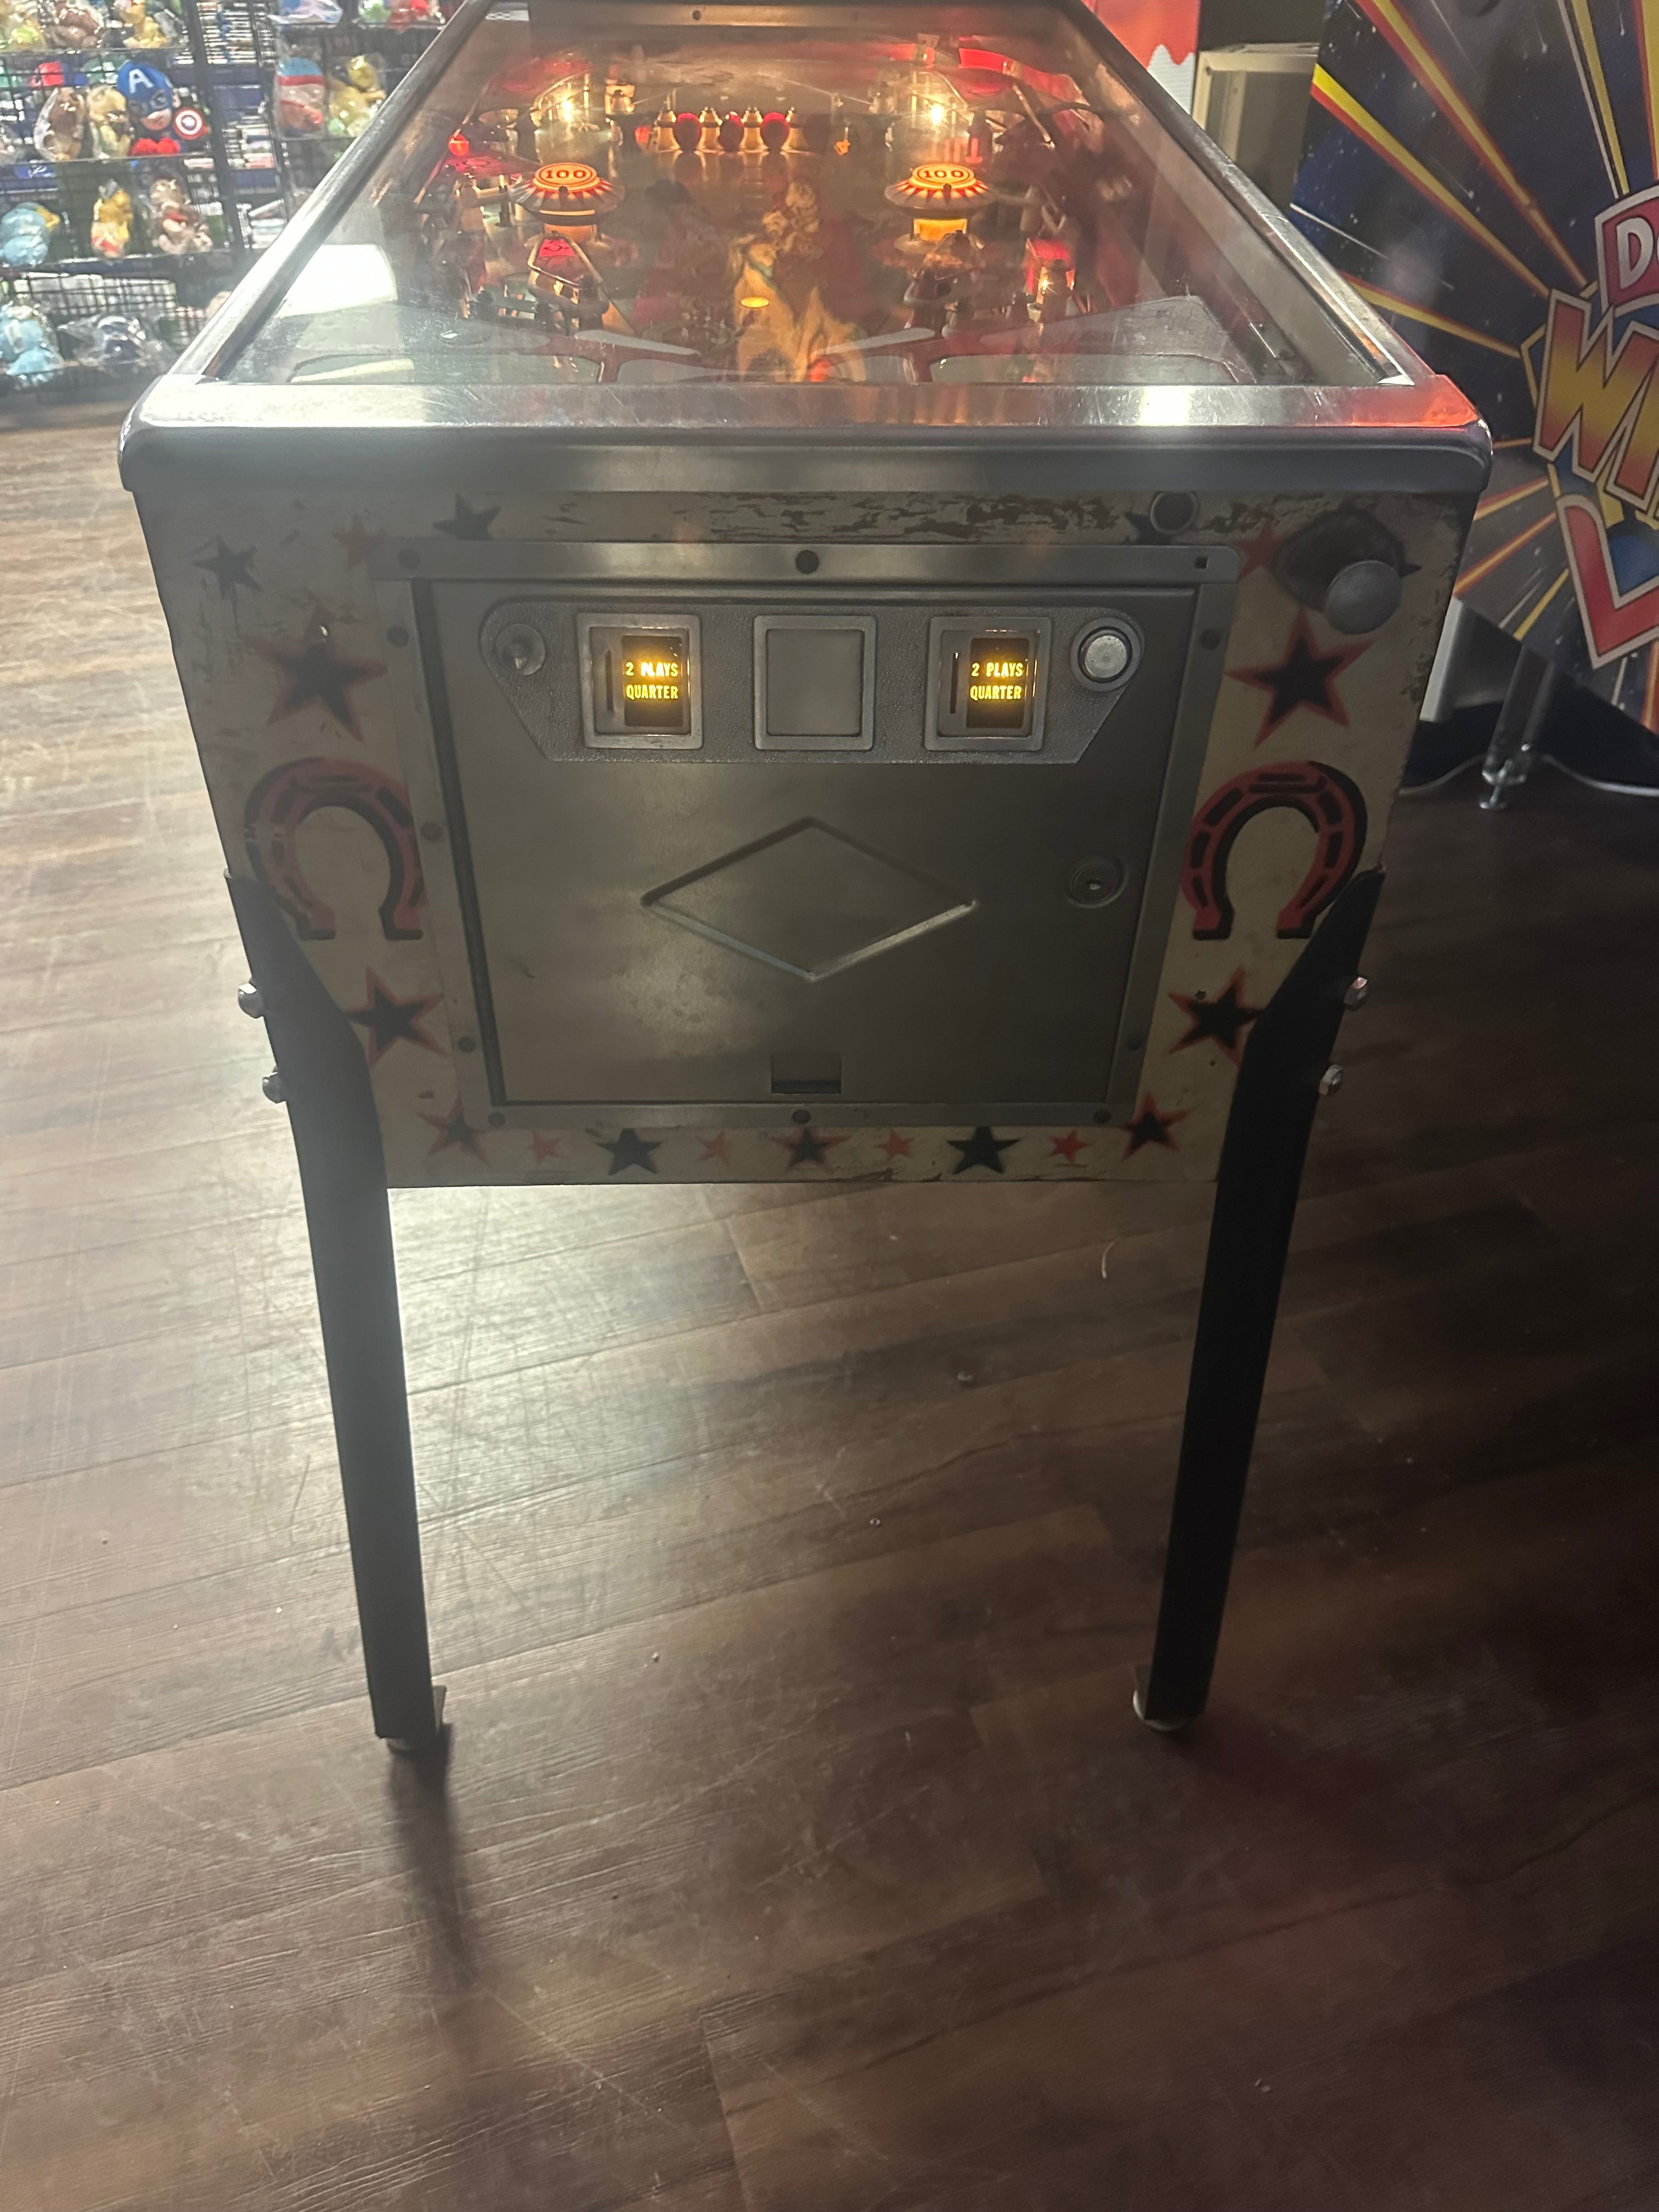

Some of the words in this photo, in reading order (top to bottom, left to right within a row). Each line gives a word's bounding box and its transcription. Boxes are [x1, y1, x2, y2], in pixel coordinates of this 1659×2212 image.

[129, 69, 154, 93] A
[545, 170, 586, 179] 100
[923, 170, 964, 178] 100
[1616, 216, 1659, 290] D
[625, 662, 634, 676] 2
[640, 662, 678, 677] PLAYS
[971, 662, 980, 676] 2
[986, 662, 1023, 677] PLAYS
[626, 684, 678, 700] QUARTER
[970, 685, 1022, 701] QUARTER
